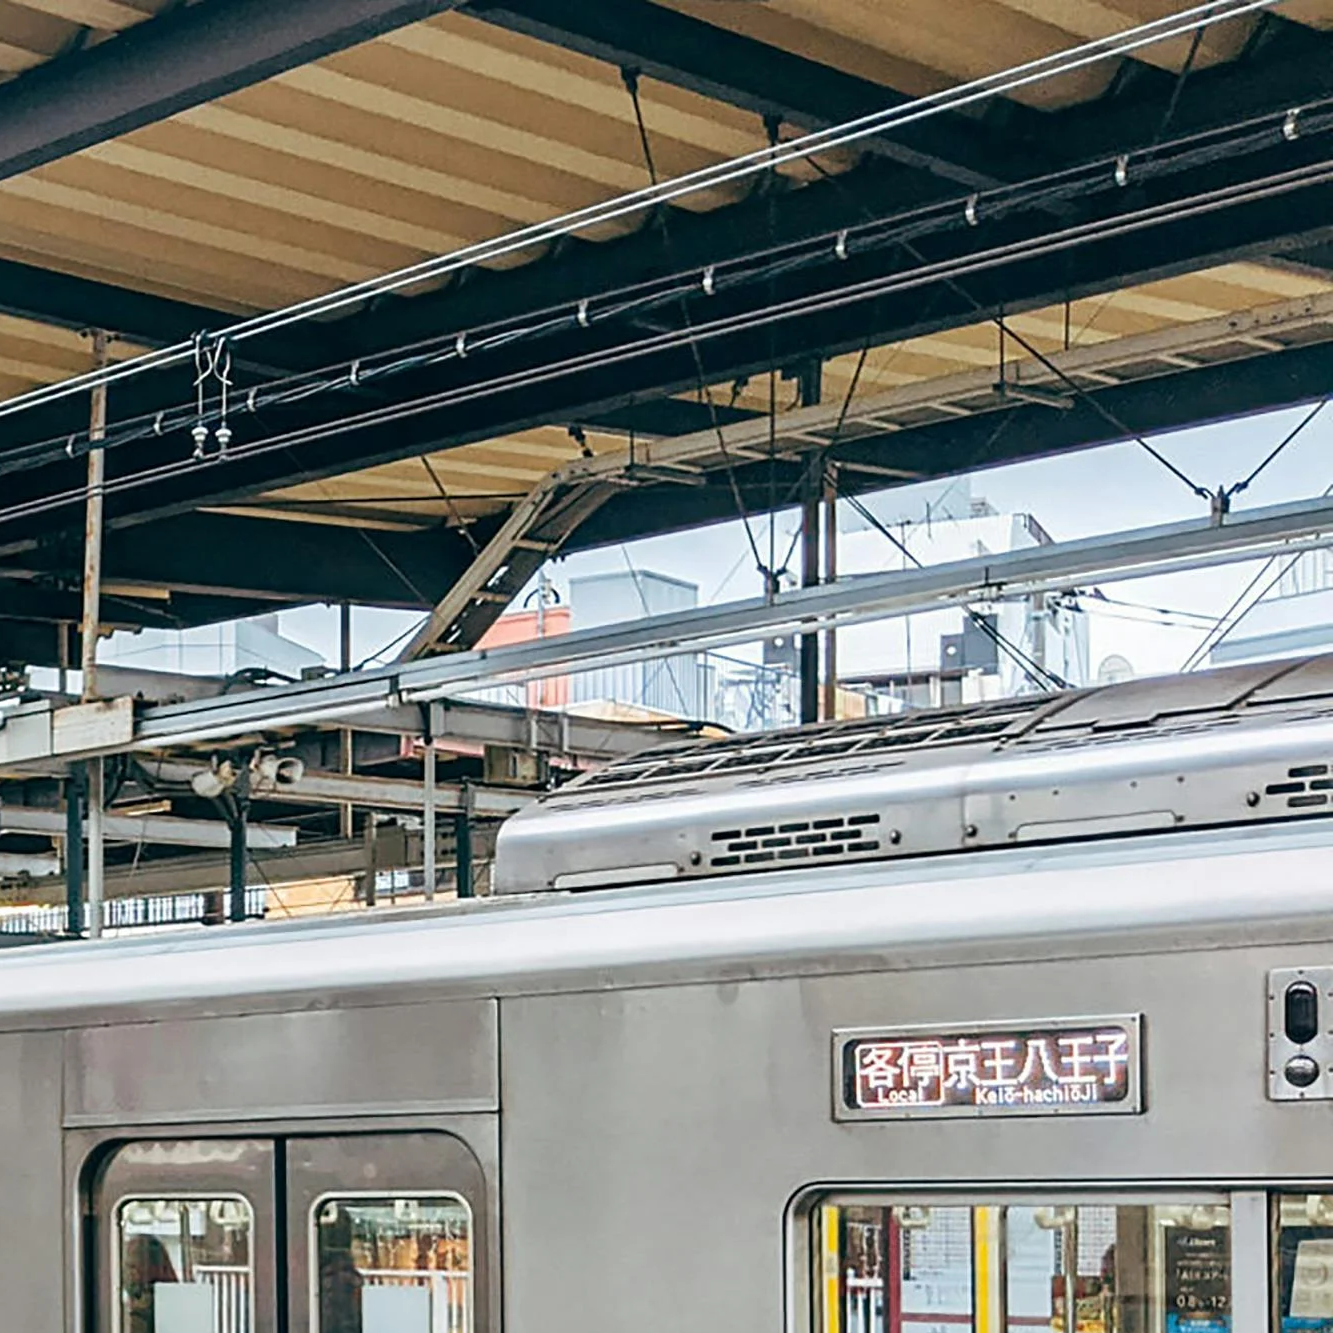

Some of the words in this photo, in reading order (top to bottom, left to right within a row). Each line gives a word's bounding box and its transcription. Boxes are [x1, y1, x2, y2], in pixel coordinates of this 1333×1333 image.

[860, 1046, 939, 1089] 各停
[943, 1035, 1128, 1089] 京王八王子
[878, 1087, 923, 1103] Local
